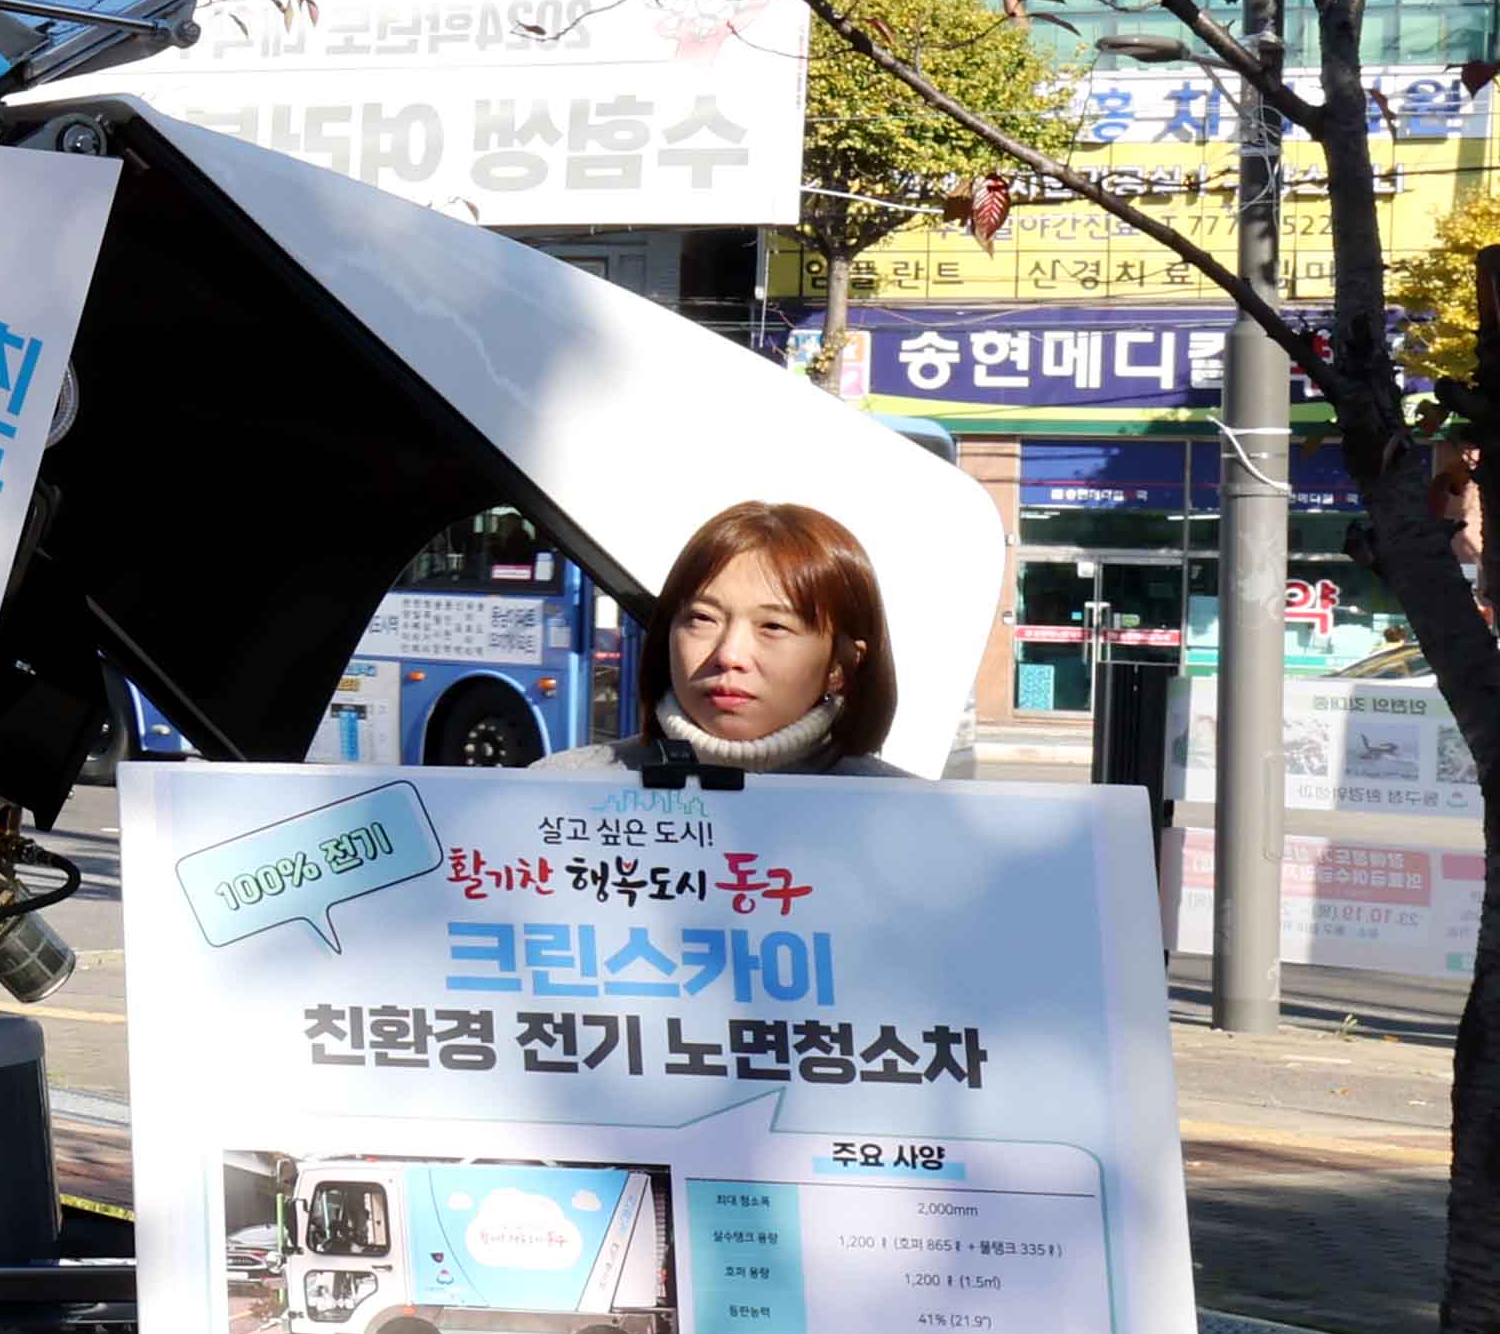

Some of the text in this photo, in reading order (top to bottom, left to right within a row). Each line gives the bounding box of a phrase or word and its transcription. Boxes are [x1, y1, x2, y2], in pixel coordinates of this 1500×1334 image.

[539, 817, 714, 848] 살고 싶은 도시!
[214, 822, 393, 911] 100% 전기
[446, 848, 813, 915] 활기찬 행복도시 동구
[446, 922, 836, 1006] 크린스카이
[303, 1004, 988, 1090] 친환경 전기 노면청소차
[832, 1142, 946, 1170] 주요 사양
[917, 1202, 978, 1216] 2,000mm
[838, 1235, 875, 1250] 1,200
[905, 1273, 940, 1287] 1,200
[918, 1313, 946, 1326] 41%
